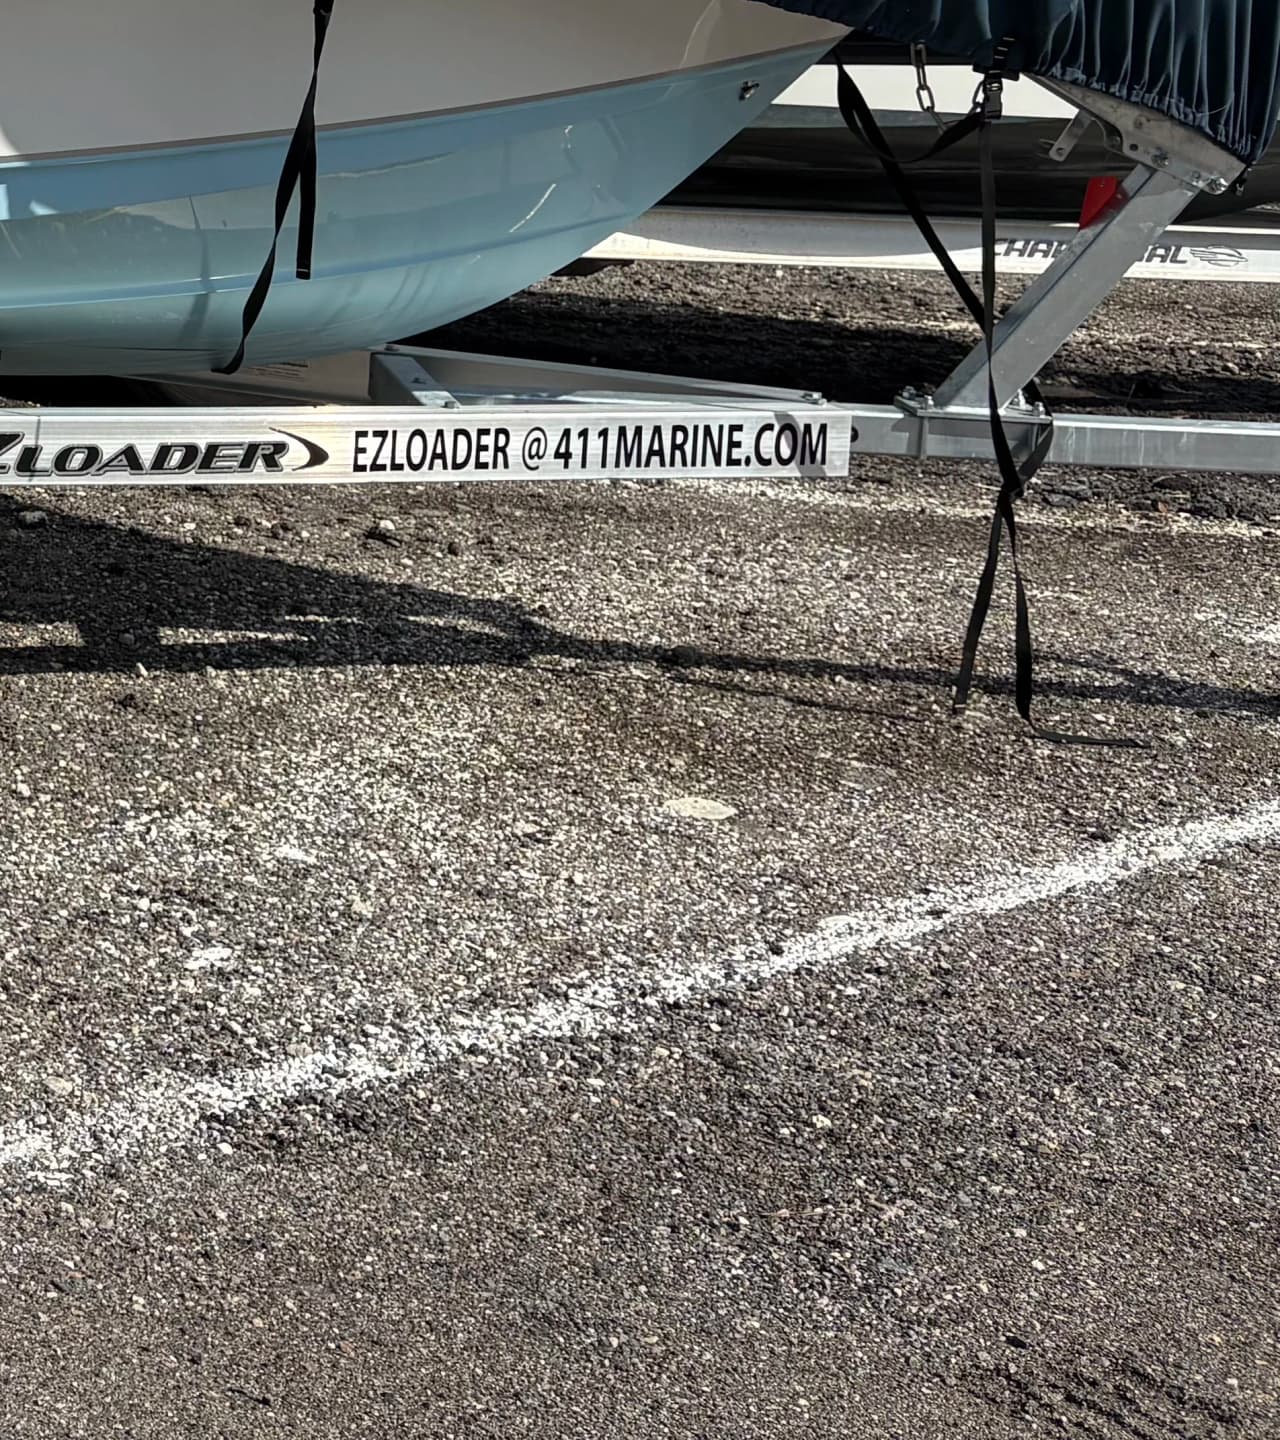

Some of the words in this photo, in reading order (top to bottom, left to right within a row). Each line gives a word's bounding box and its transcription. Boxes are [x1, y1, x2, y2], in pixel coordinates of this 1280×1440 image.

[995, 238, 1187, 264] CHAAL
[352, 427, 510, 473] EZLOADER
[522, 426, 548, 471] @
[553, 422, 829, 468] 411MARINE.COM
